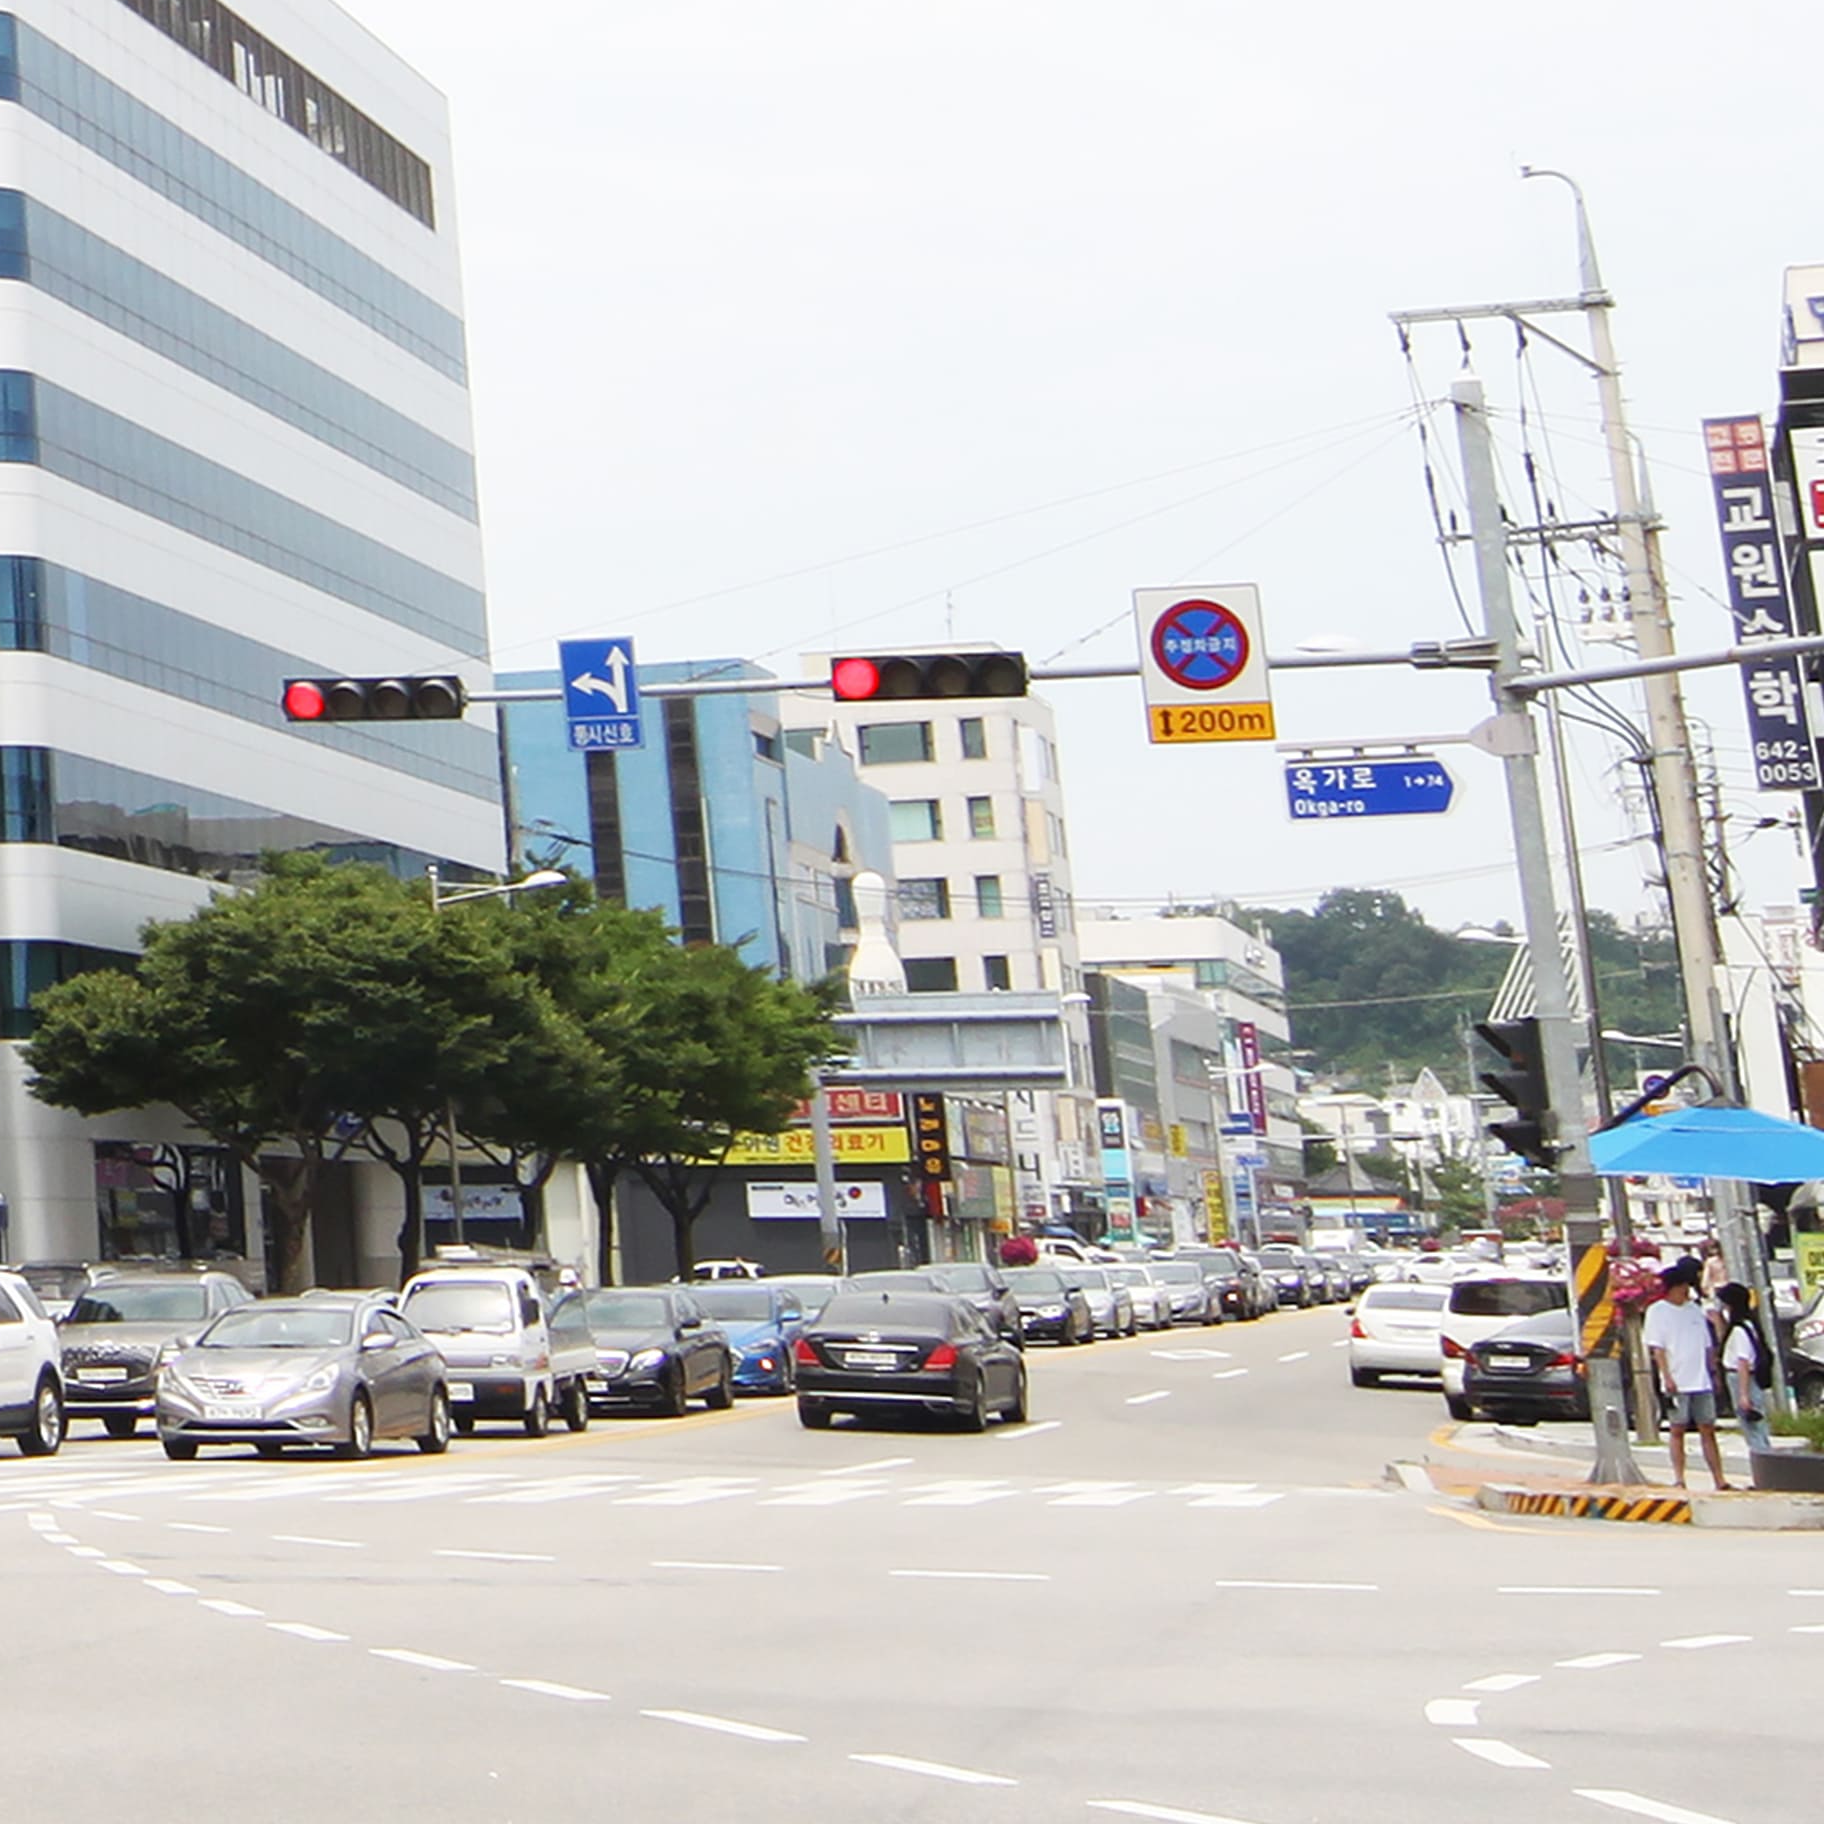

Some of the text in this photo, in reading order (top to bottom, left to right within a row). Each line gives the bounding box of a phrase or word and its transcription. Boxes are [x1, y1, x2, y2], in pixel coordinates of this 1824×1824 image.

[1165, 637, 1236, 655] 주정차금지
[1181, 708, 1265, 733] 200m
[573, 723, 635, 745] 동시신호
[1293, 766, 1377, 795] 옥가로
[1760, 763, 1816, 783] 0053
[1294, 798, 1365, 816] Okga-ro
